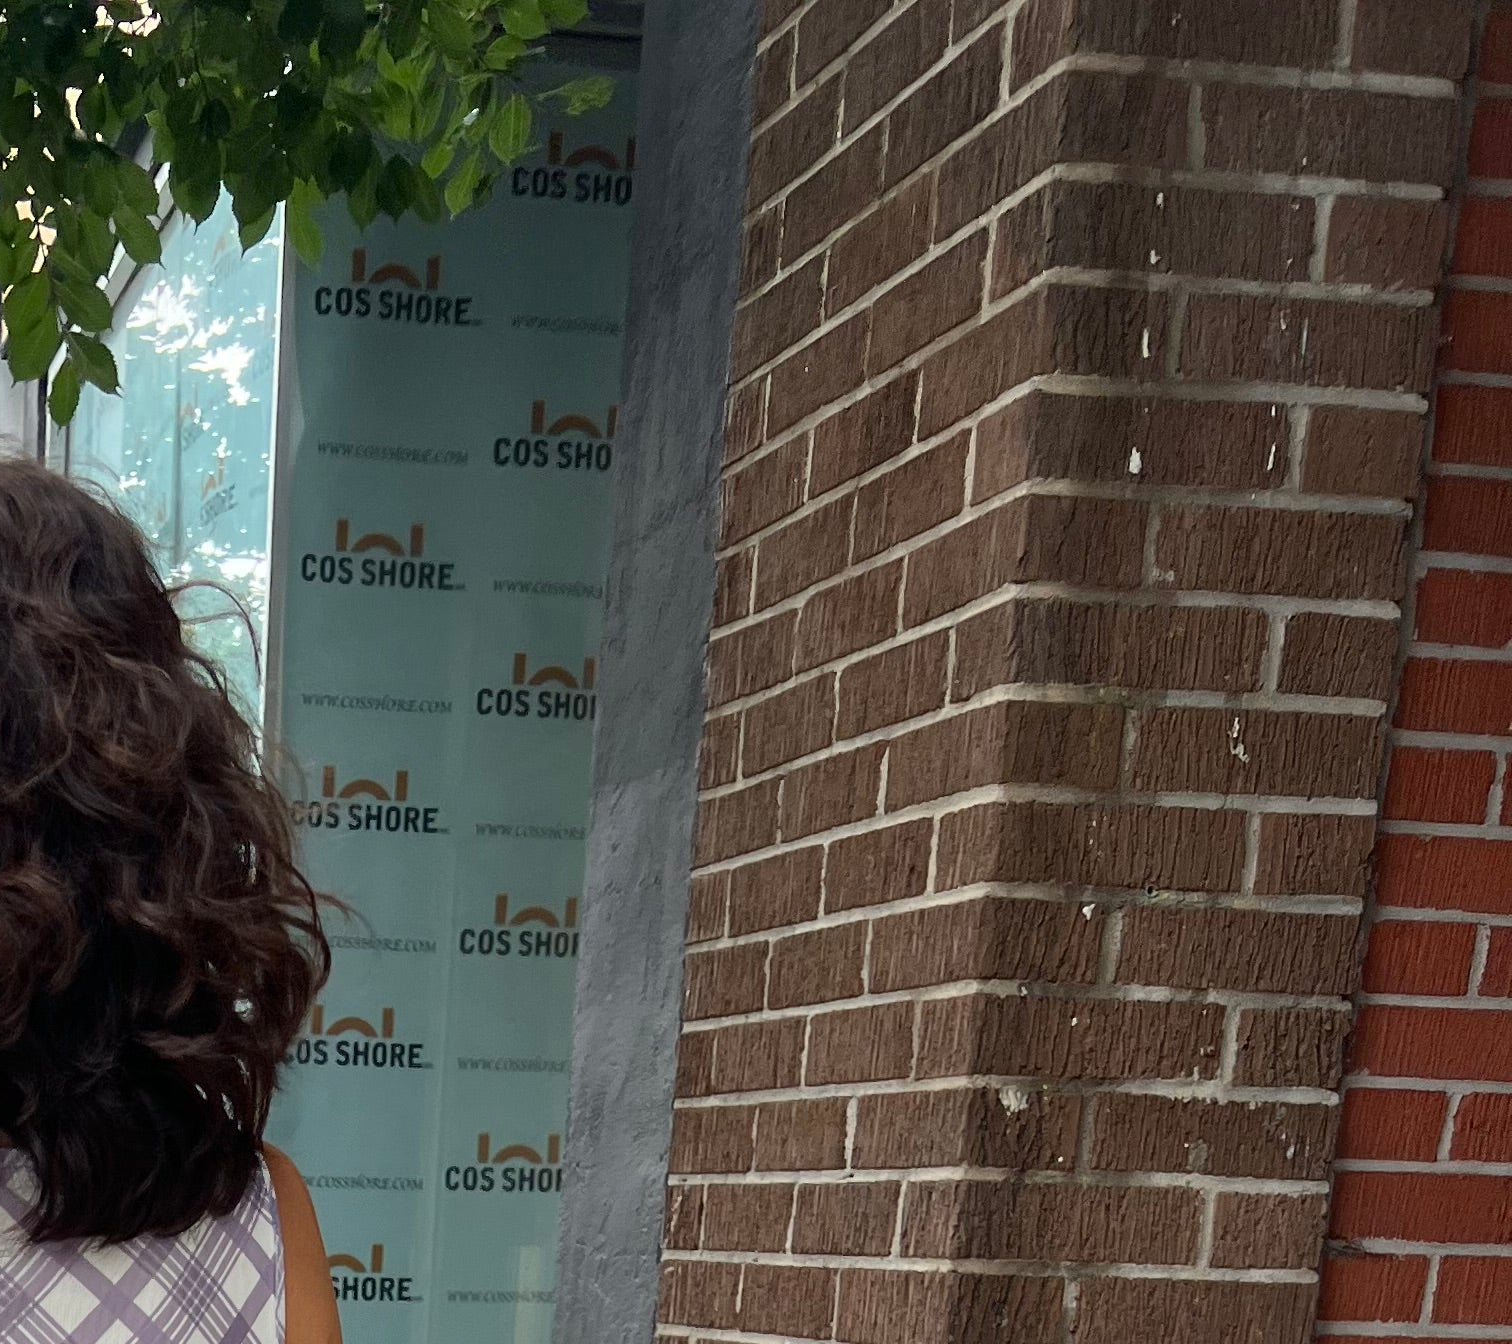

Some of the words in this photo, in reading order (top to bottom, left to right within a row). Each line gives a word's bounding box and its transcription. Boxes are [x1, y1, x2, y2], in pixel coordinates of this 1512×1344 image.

[512, 166, 567, 199] COS
[575, 172, 633, 206] SHO
[315, 286, 371, 317] COS
[378, 289, 473, 327] SHORE
[493, 438, 549, 469] COS
[556, 440, 613, 471] SHO
[301, 553, 354, 585] COS
[361, 557, 455, 591] SHORE
[476, 688, 530, 718] COS
[537, 691, 596, 721] SHO
[348, 803, 439, 834] SHORE
[459, 928, 511, 957] COS
[518, 930, 579, 959] SHO
[295, 1039, 329, 1066] OS
[335, 1039, 423, 1069] SHORE
[445, 1165, 494, 1192] COS
[501, 1166, 561, 1193] SHO
